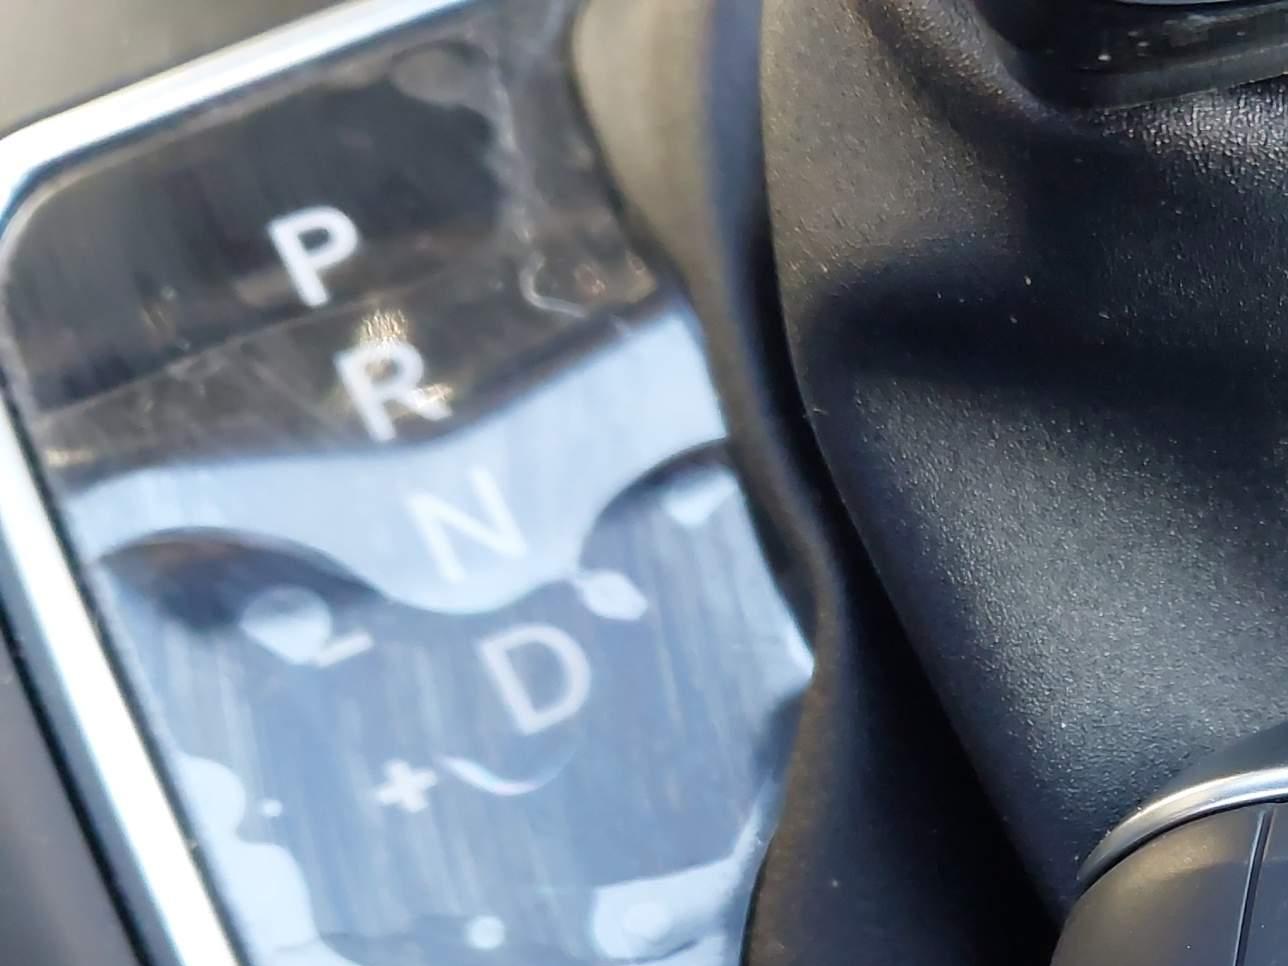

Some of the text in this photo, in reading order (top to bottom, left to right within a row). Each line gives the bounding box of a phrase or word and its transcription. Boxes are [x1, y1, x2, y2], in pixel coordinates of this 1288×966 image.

[267, 205, 359, 308] P
[333, 339, 453, 443] R
[405, 465, 528, 583] N
[476, 621, 593, 737] D
